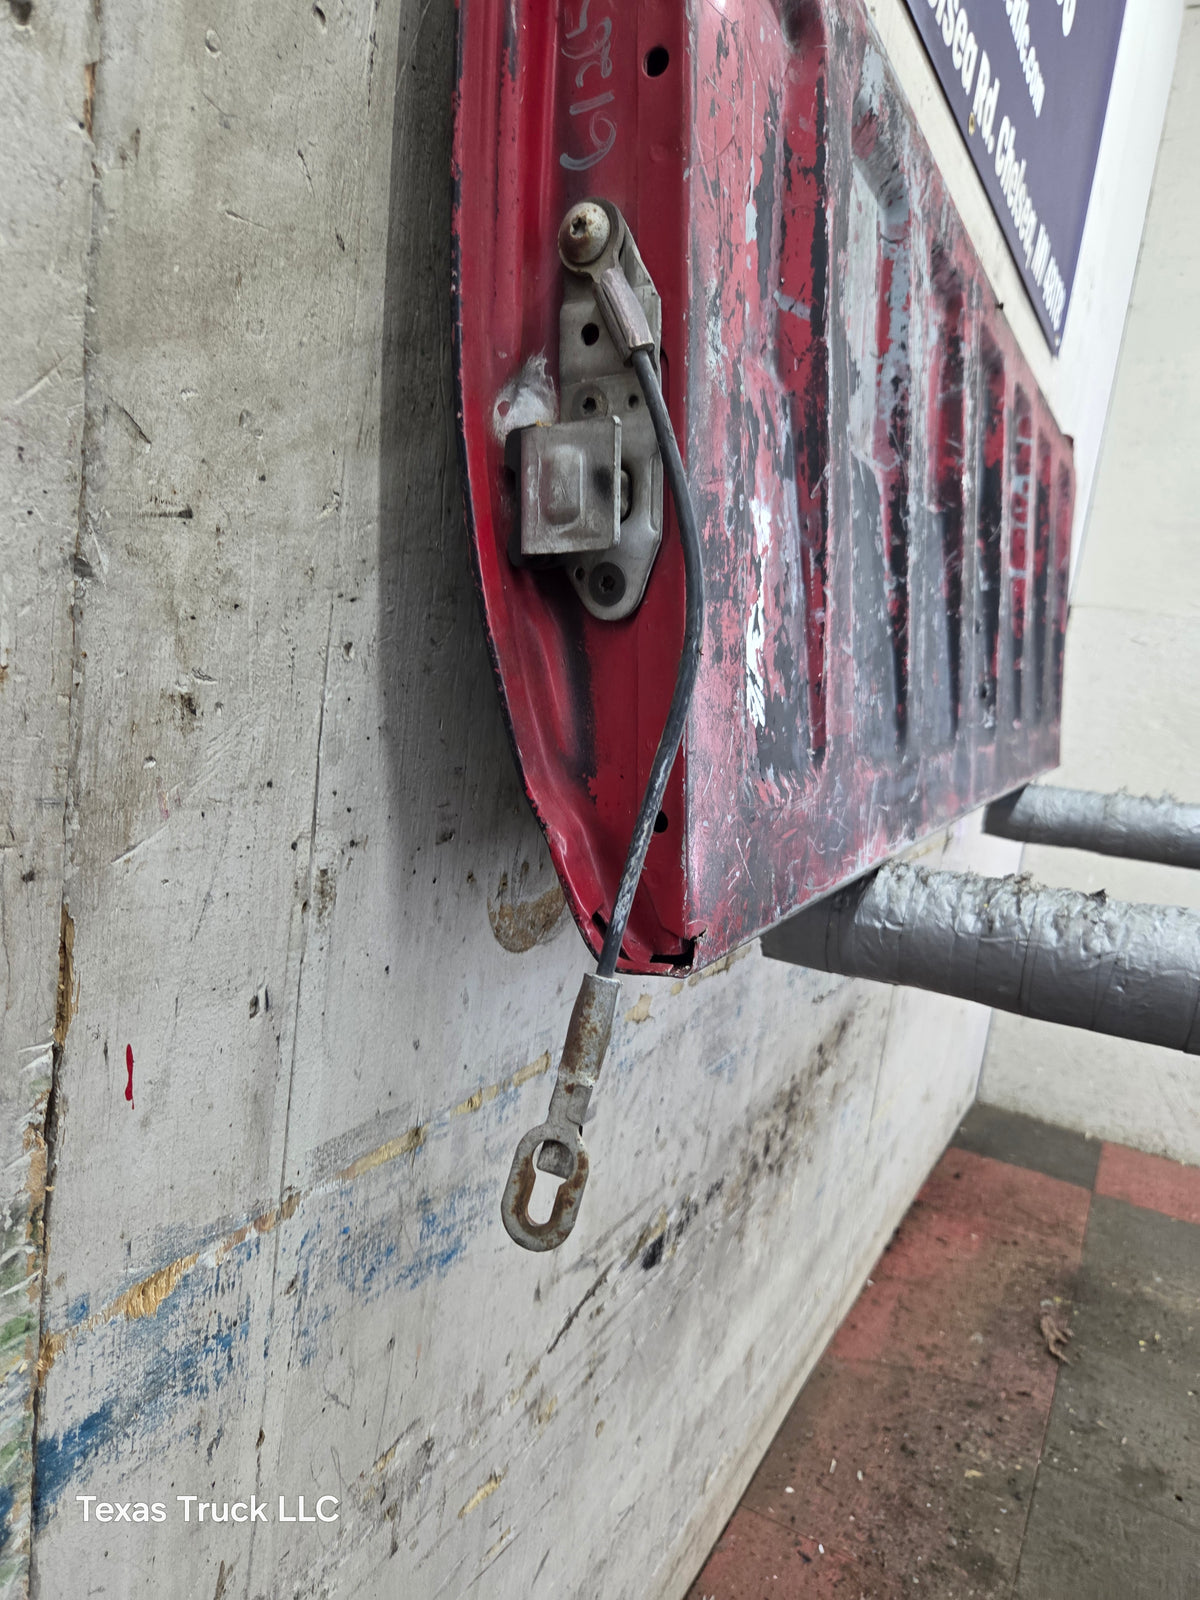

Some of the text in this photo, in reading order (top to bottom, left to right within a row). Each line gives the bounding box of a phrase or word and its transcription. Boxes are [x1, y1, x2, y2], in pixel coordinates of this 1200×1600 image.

[928, 0, 978, 95] sea
[973, 50, 1000, 154] Rd.
[995, 115, 1038, 270] Chelsea,
[1031, 223, 1051, 287] MI
